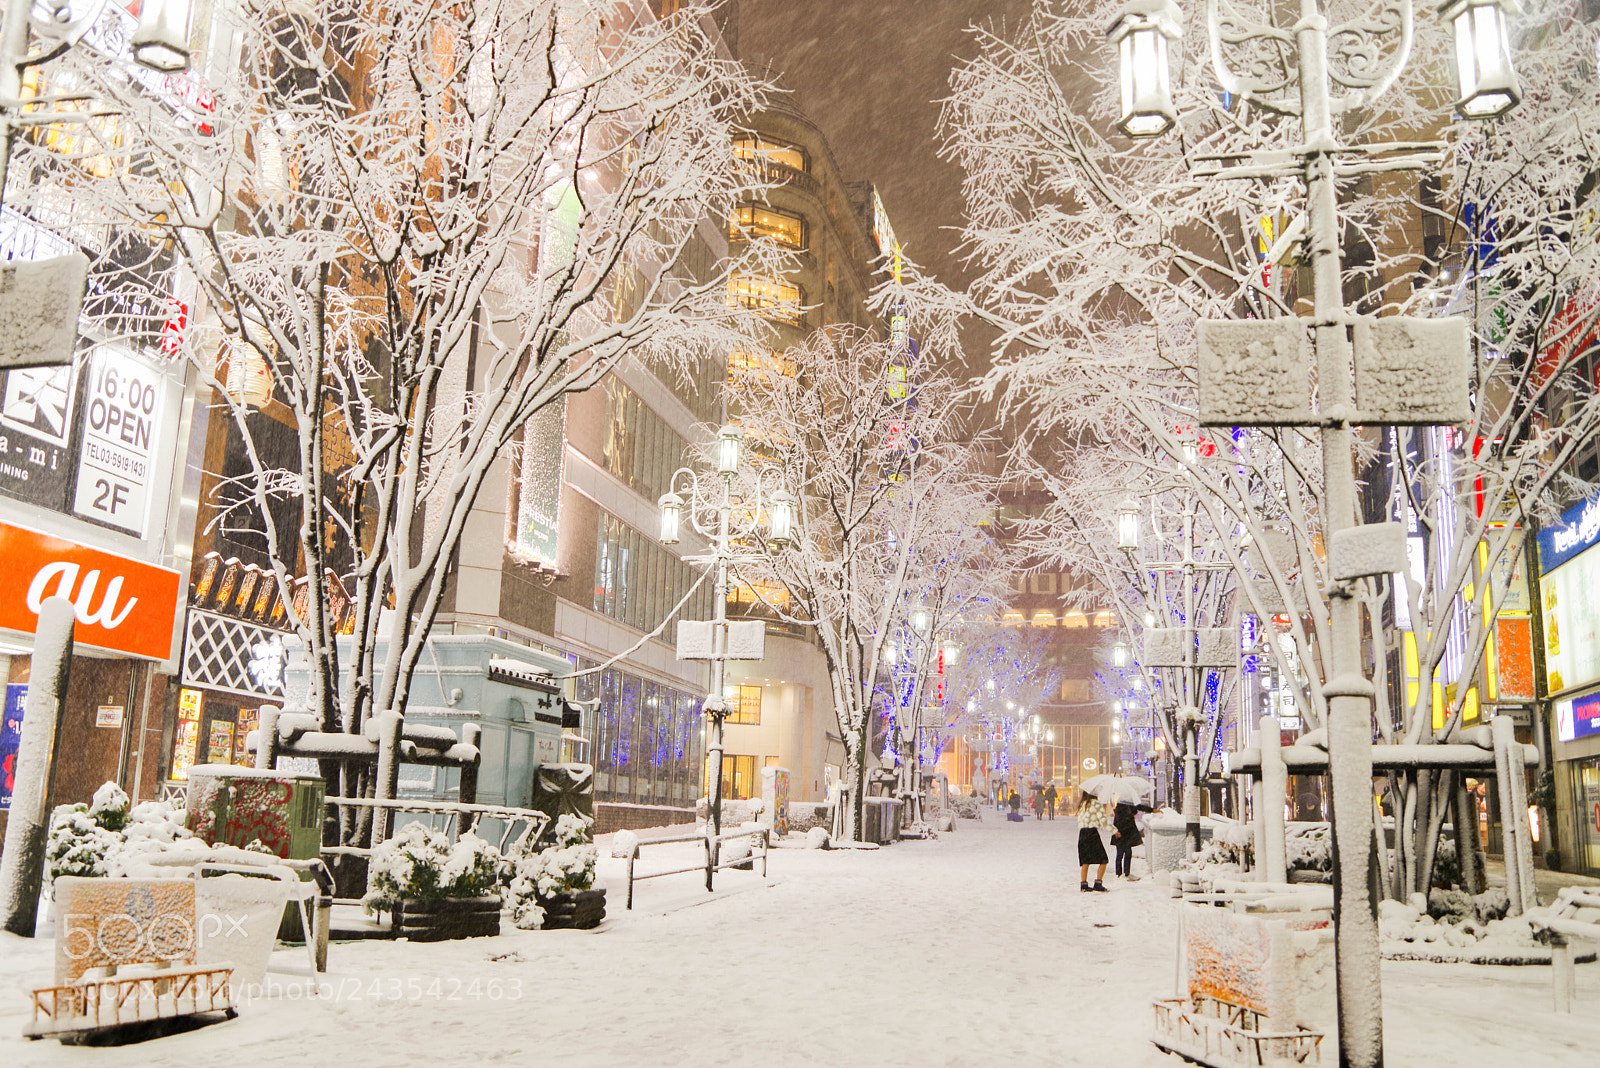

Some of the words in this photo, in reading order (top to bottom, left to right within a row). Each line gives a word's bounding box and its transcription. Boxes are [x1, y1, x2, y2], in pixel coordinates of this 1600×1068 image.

[96, 361, 156, 415] 16:00
[90, 398, 152, 450] OPEN
[92, 478, 130, 514] 2F
[26, 561, 139, 630] au
